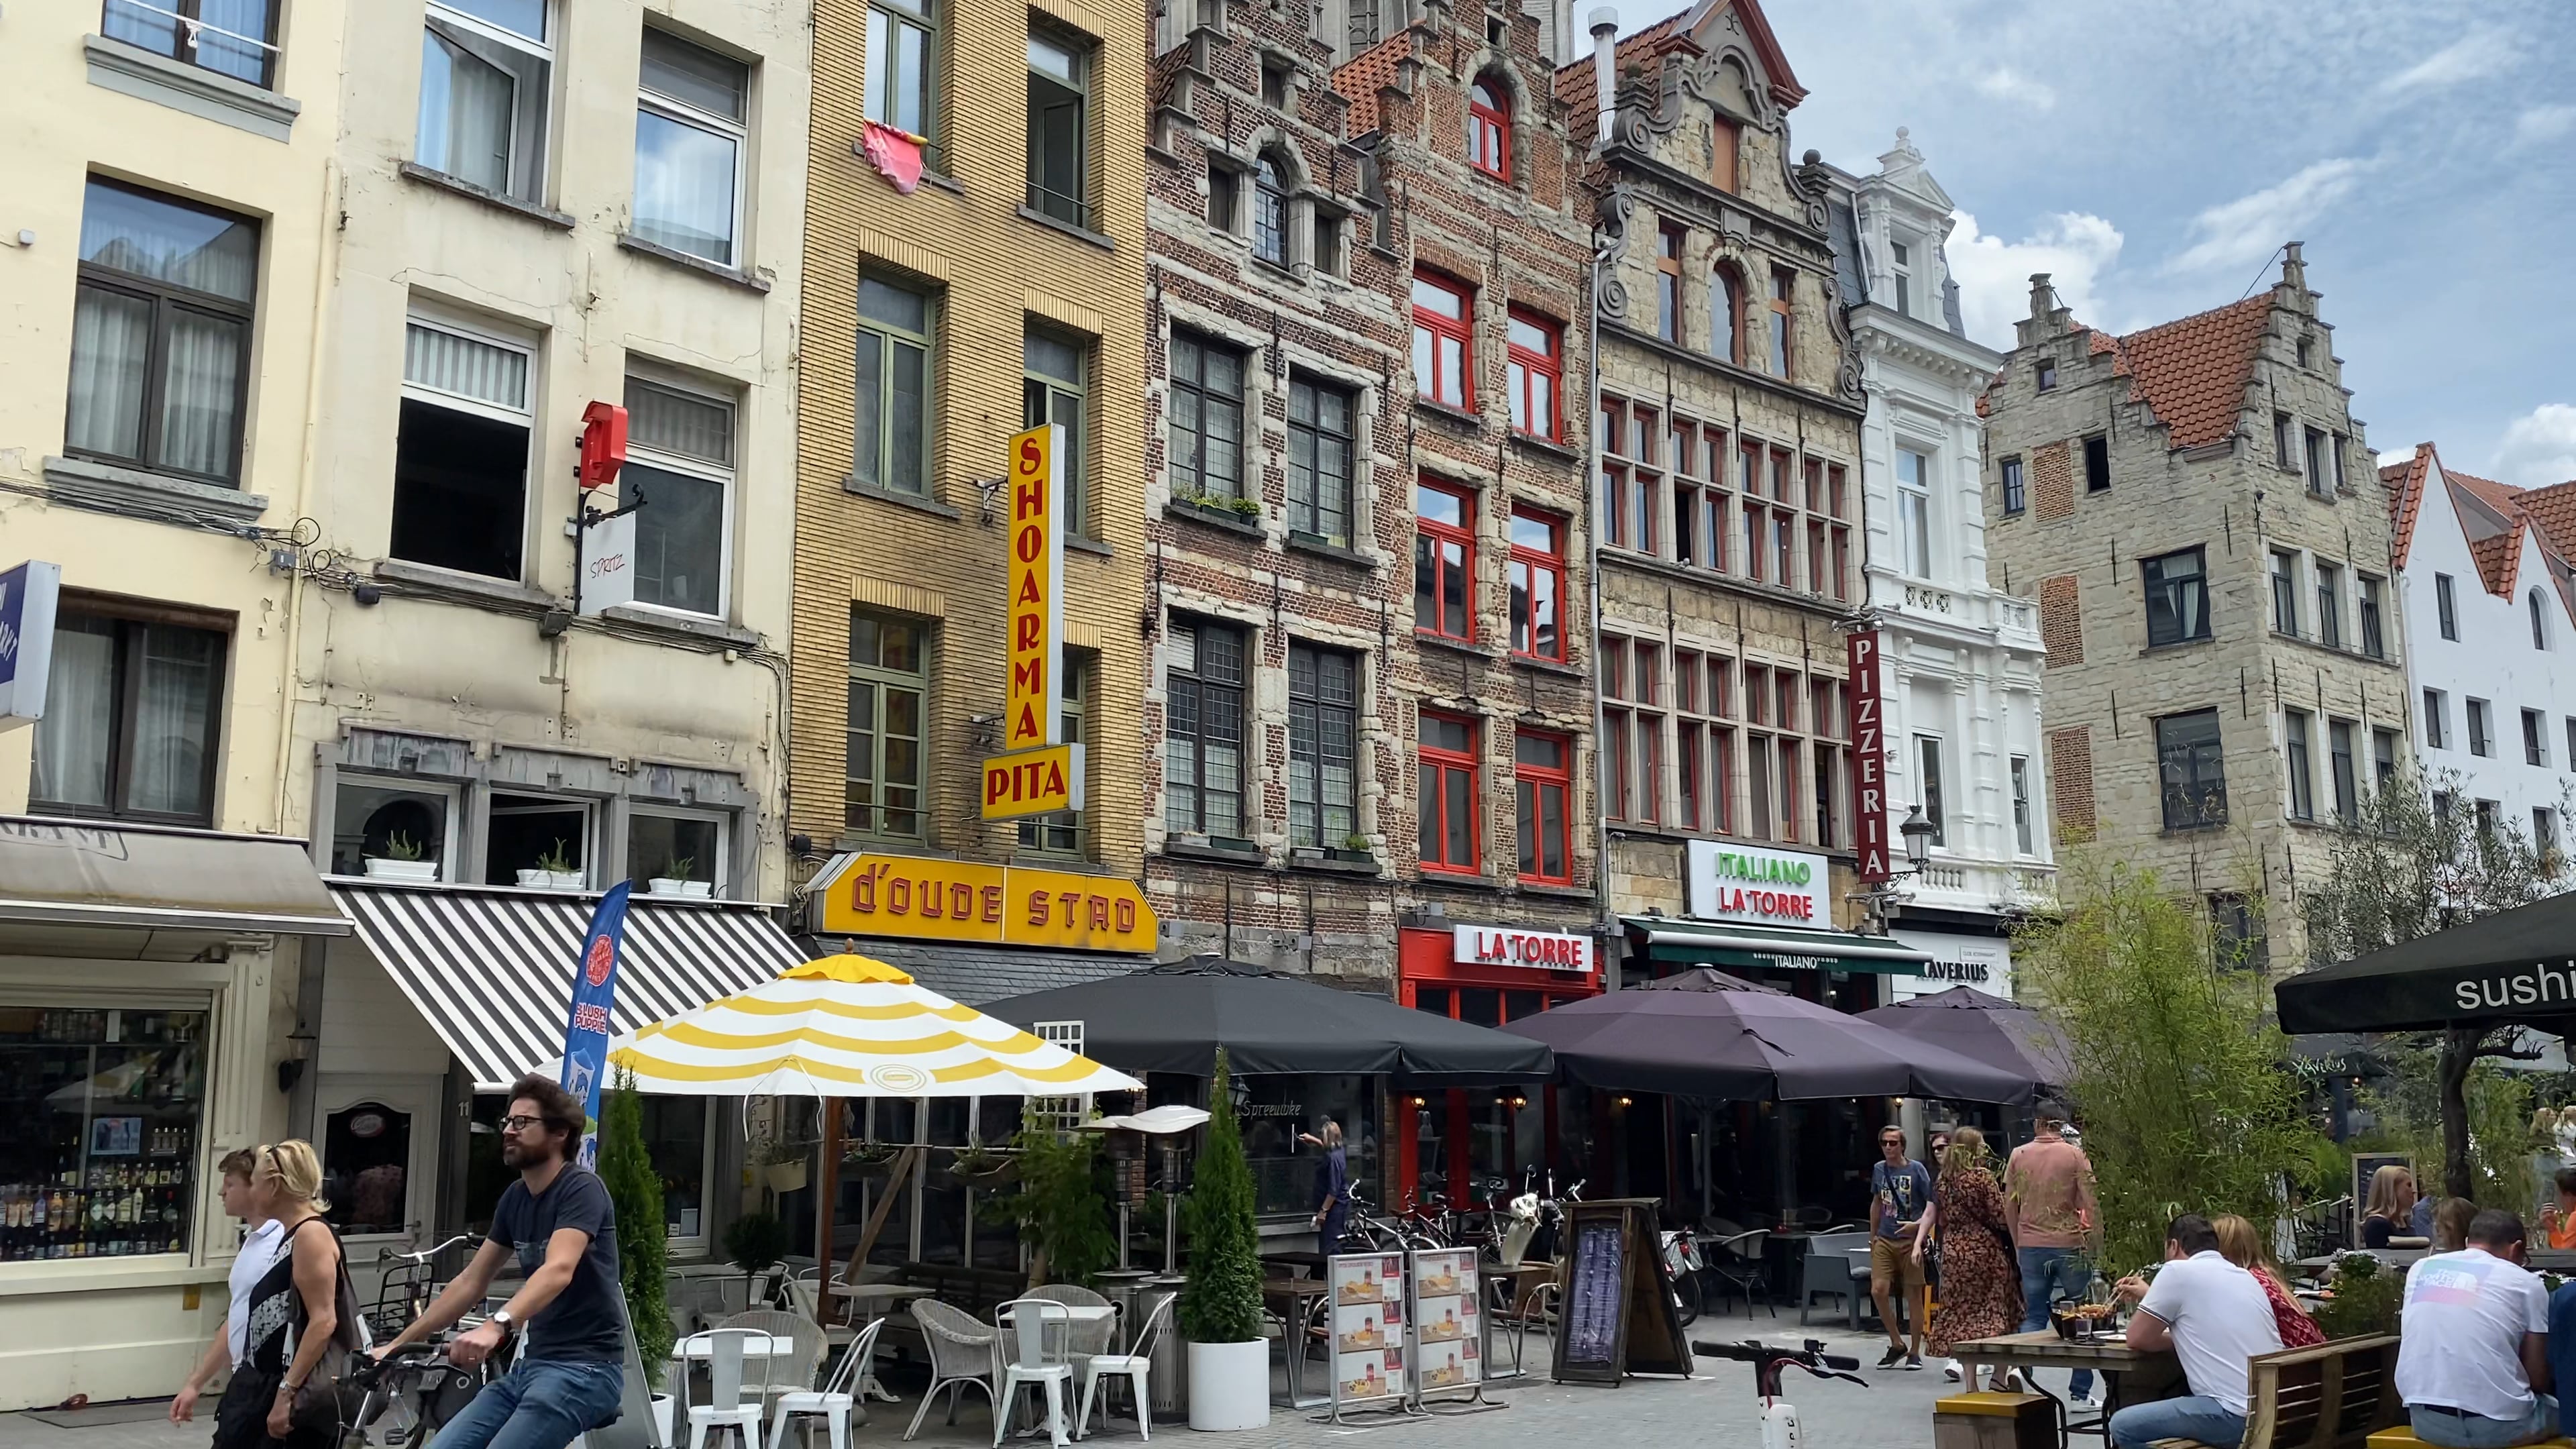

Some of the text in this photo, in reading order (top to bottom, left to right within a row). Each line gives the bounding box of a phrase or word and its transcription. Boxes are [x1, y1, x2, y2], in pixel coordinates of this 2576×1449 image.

[590, 553, 625, 578] SPRITZ
[1014, 437, 1043, 741] SHOARMA
[1856, 639, 1884, 875] PIZZERIA
[987, 760, 1066, 806] PITA
[1716, 852, 1811, 885] ITALIANO
[853, 863, 1136, 933] d'OUDE STAD
[1719, 886, 1813, 918] LA TORRE
[1477, 931, 1582, 966] LA TORRE
[1775, 955, 1817, 969] ITALIANO
[1923, 961, 1990, 981] AVERIUS
[2455, 960, 2576, 1010] sushi
[576, 1003, 607, 1021] SLUSH
[458, 1102, 470, 1117] 11
